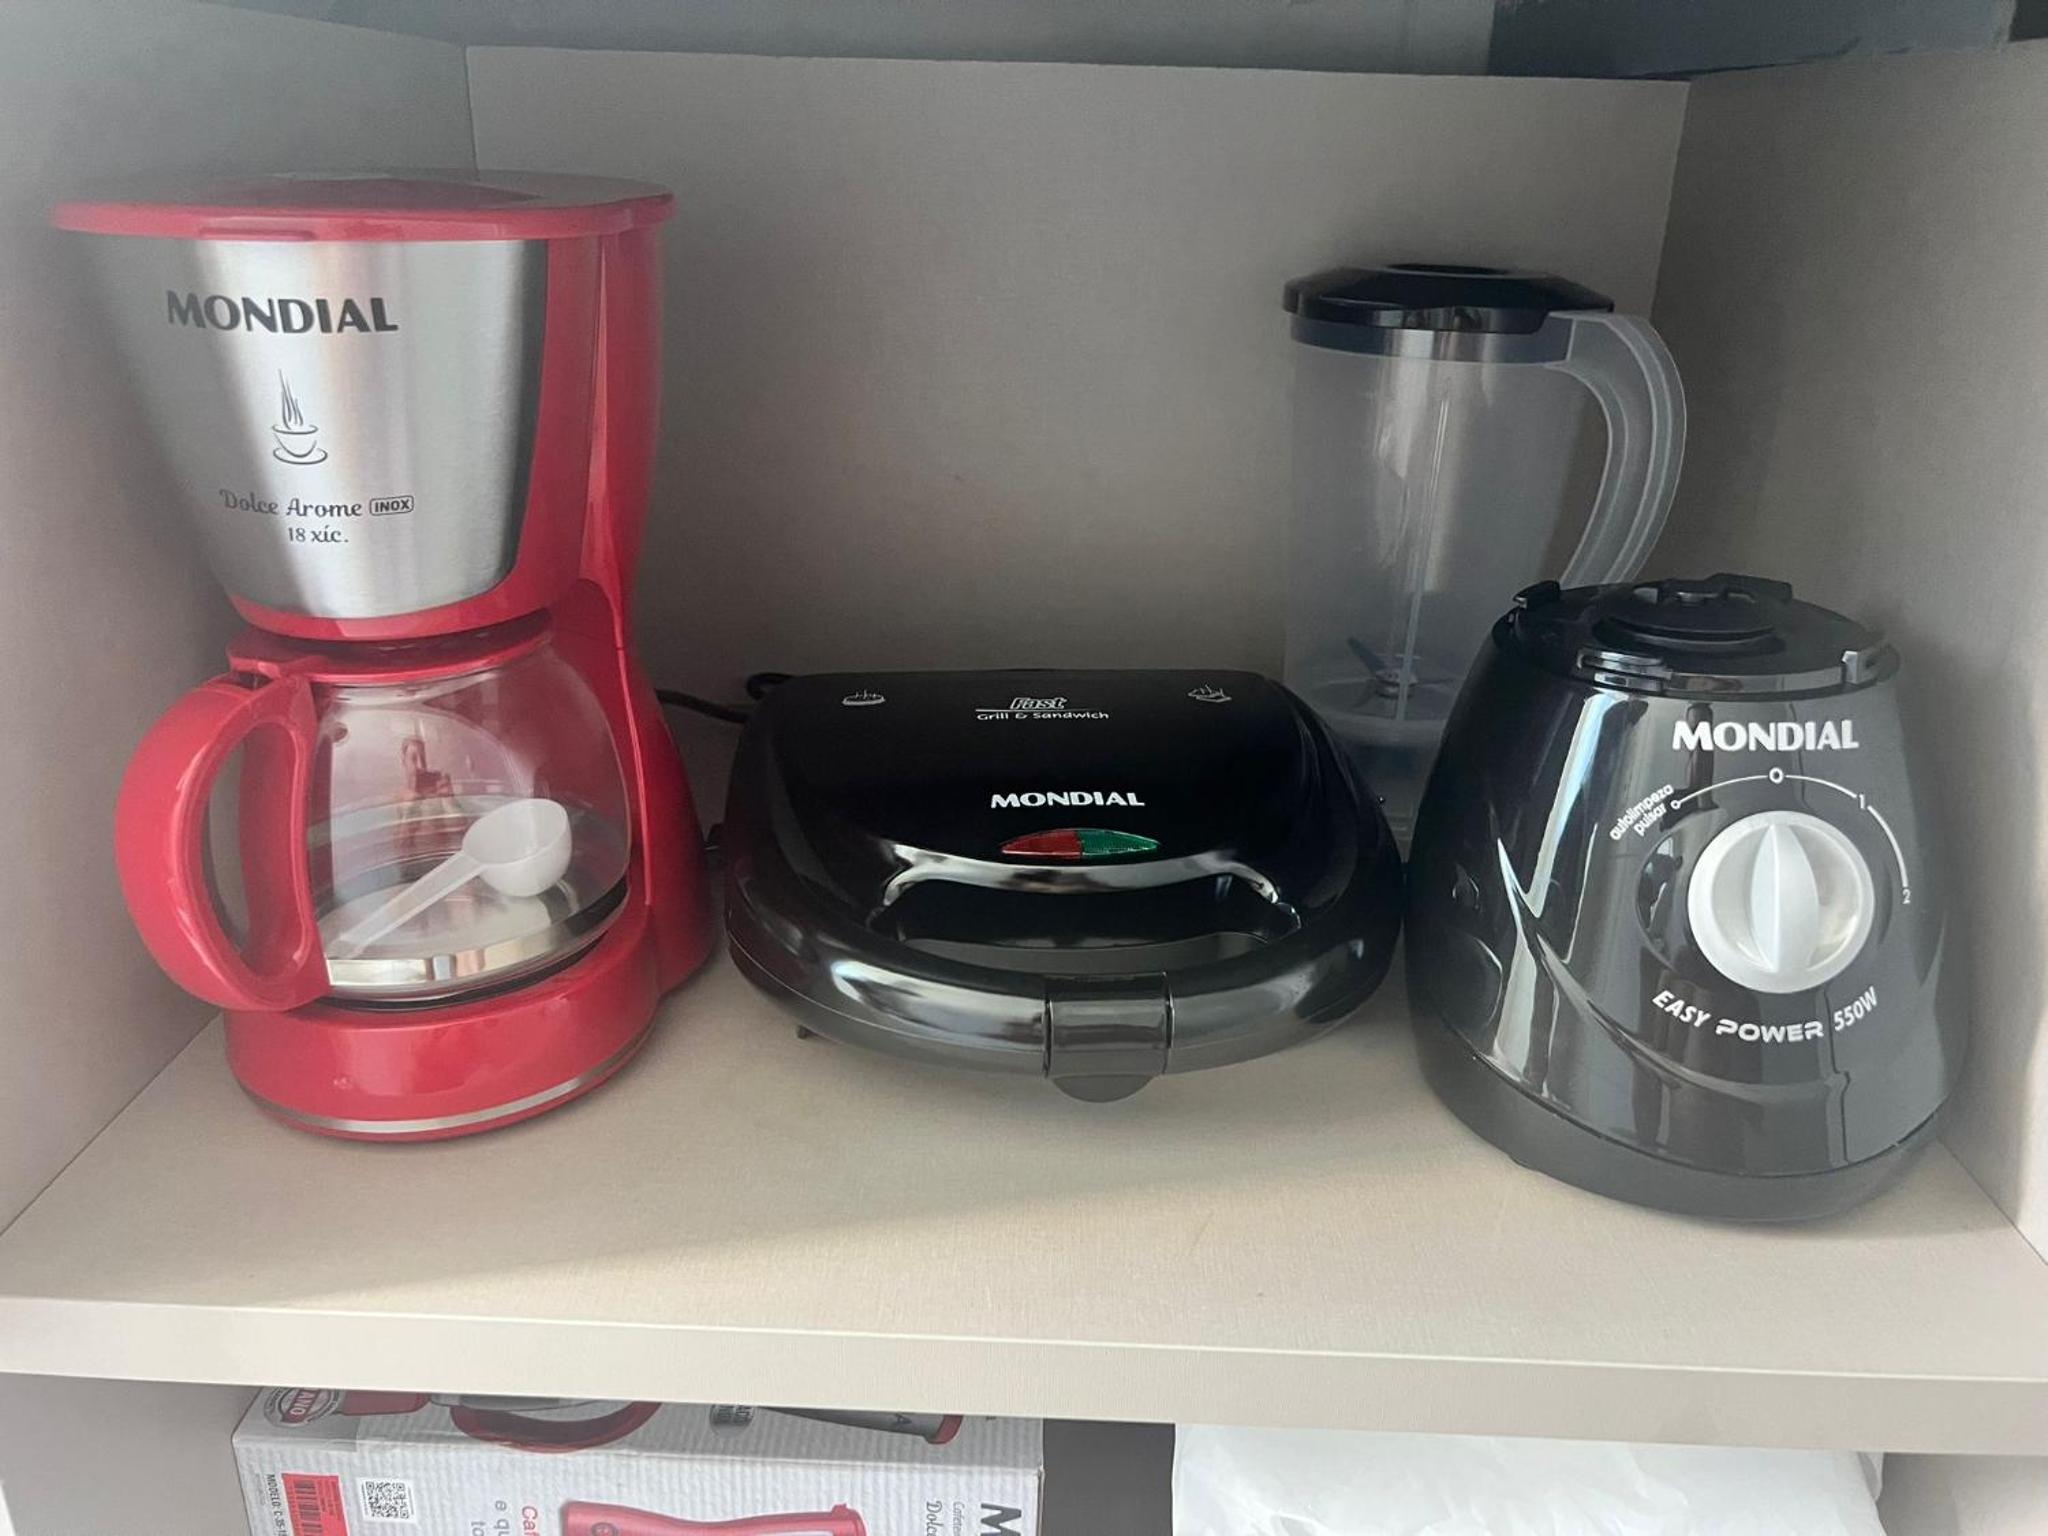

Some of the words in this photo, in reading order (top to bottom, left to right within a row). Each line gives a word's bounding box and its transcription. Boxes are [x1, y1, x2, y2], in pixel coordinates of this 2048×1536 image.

[166, 290, 399, 334] MONDIAL
[220, 489, 278, 515] Dolce
[286, 498, 362, 517] Arome
[373, 499, 411, 513] INOX
[287, 527, 306, 542] 18
[311, 525, 349, 543] xíc.
[1010, 697, 1067, 709] Fast
[976, 712, 1009, 721] Grill
[1033, 711, 1109, 720] Sandwich
[1672, 719, 1860, 752] MONDIAL
[990, 790, 1145, 809] MONDIAL
[1858, 794, 1866, 809] 1
[1610, 784, 1674, 840] autolimpeza
[1633, 803, 1667, 837] pulsar
[1902, 889, 1911, 904] 2
[1652, 990, 1712, 1028] EASY
[1715, 1018, 1825, 1044] POWER
[1833, 986, 1878, 1032] 550W
